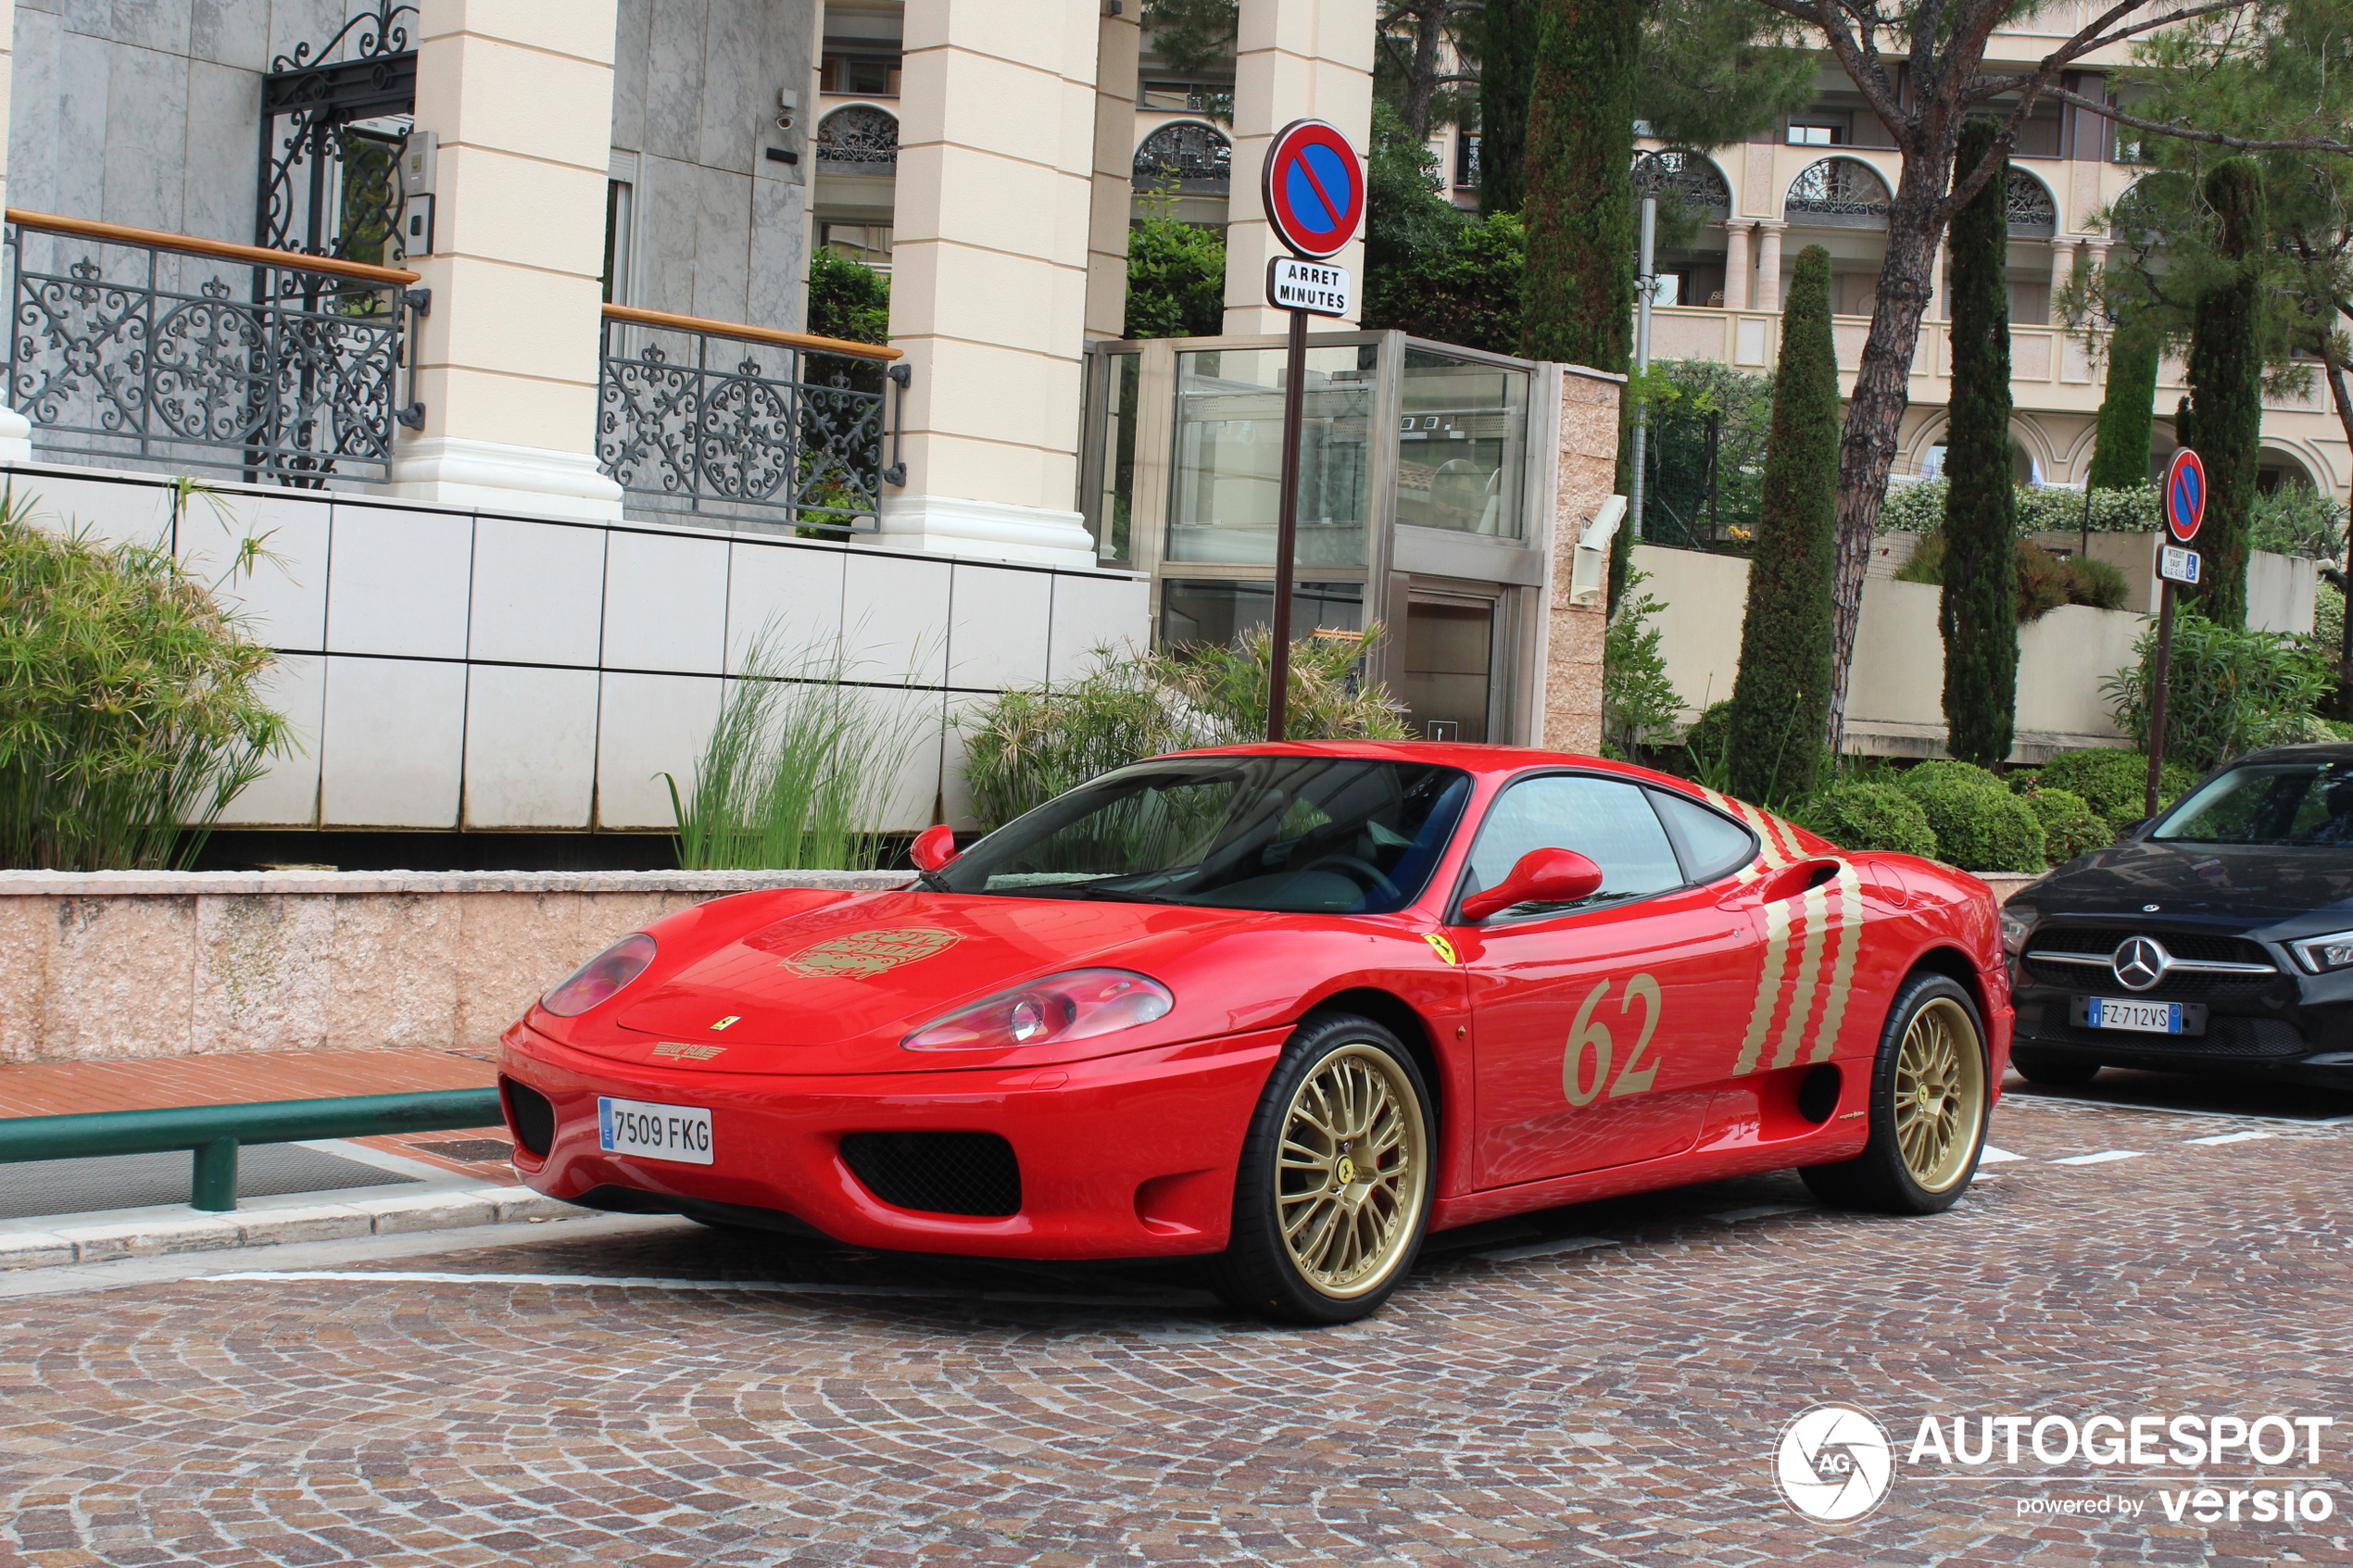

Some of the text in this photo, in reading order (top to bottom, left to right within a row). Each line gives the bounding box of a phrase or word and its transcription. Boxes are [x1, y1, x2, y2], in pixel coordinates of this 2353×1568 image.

[1288, 265, 1340, 286] ARRET
[1279, 284, 1345, 309] MINUTES
[2170, 558, 2181, 568] SAUF
[666, 1042, 710, 1057] TOP GUN
[1562, 972, 1662, 1107] 62
[604, 1129, 610, 1140] E
[615, 1110, 709, 1151] 7509 FKG
